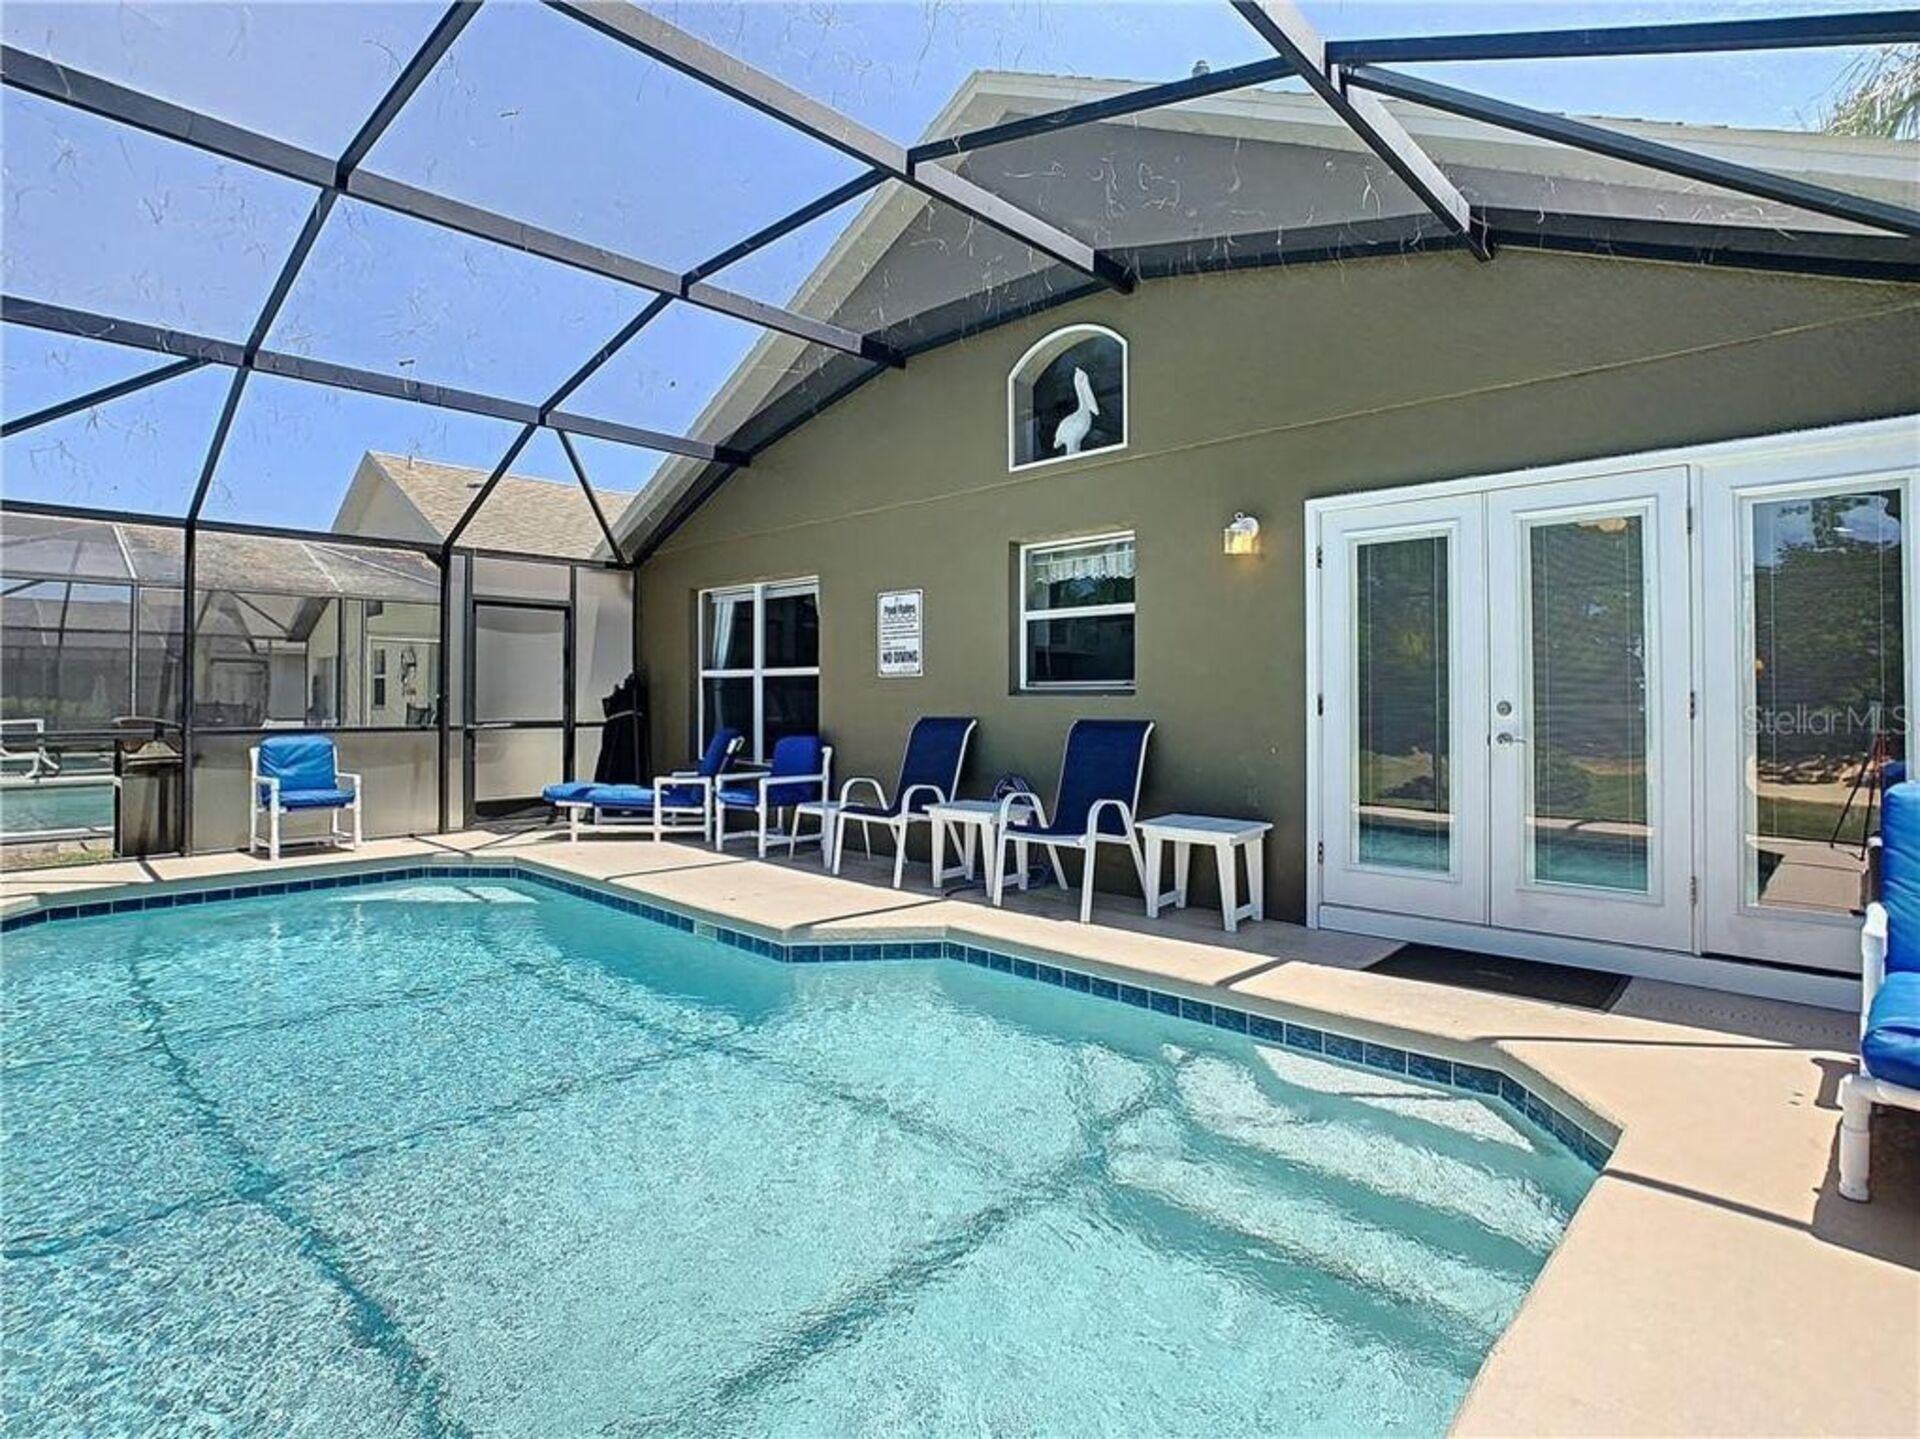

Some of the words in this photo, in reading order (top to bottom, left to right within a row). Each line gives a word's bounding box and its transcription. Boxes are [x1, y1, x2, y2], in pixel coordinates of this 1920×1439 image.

[898, 604, 916, 614] Rules
[883, 651, 893, 664] NO
[894, 650, 918, 664] DIVING
